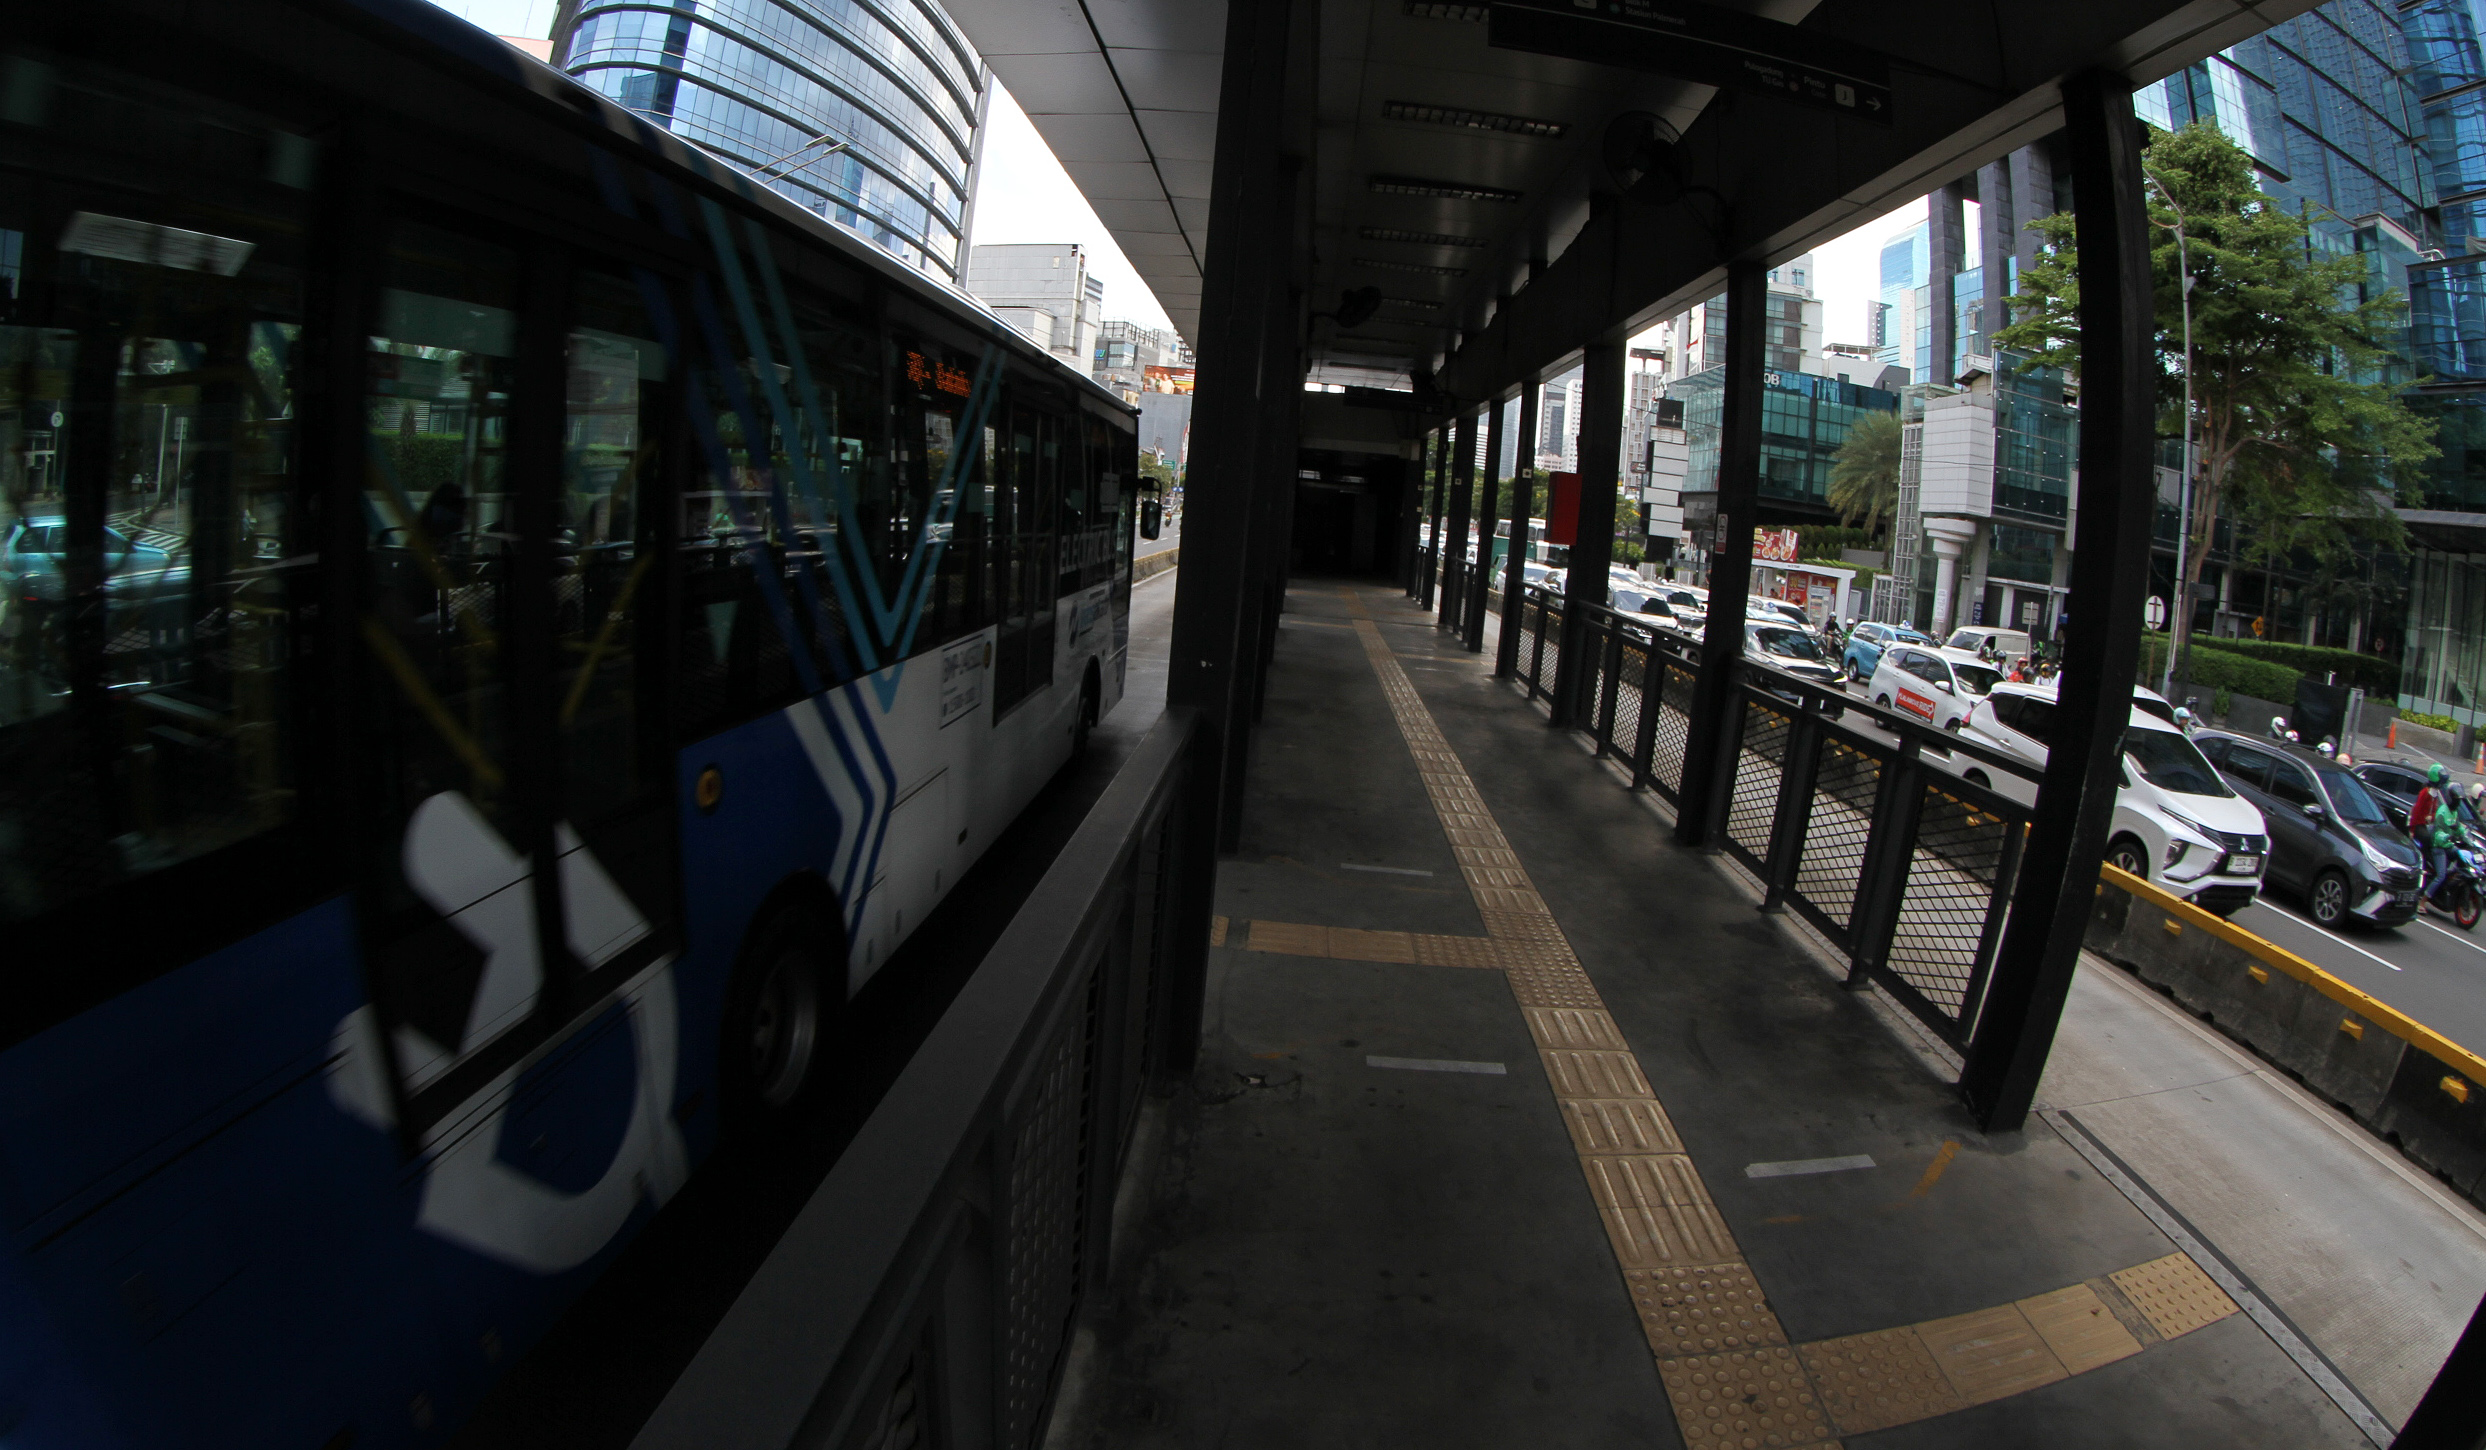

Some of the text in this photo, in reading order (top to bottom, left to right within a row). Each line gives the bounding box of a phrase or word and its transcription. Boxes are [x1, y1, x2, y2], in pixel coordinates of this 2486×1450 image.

[1625, 6, 1652, 18] Stasiun
[1803, 75, 1826, 89] Pintu
[1763, 372, 1780, 386] OB
